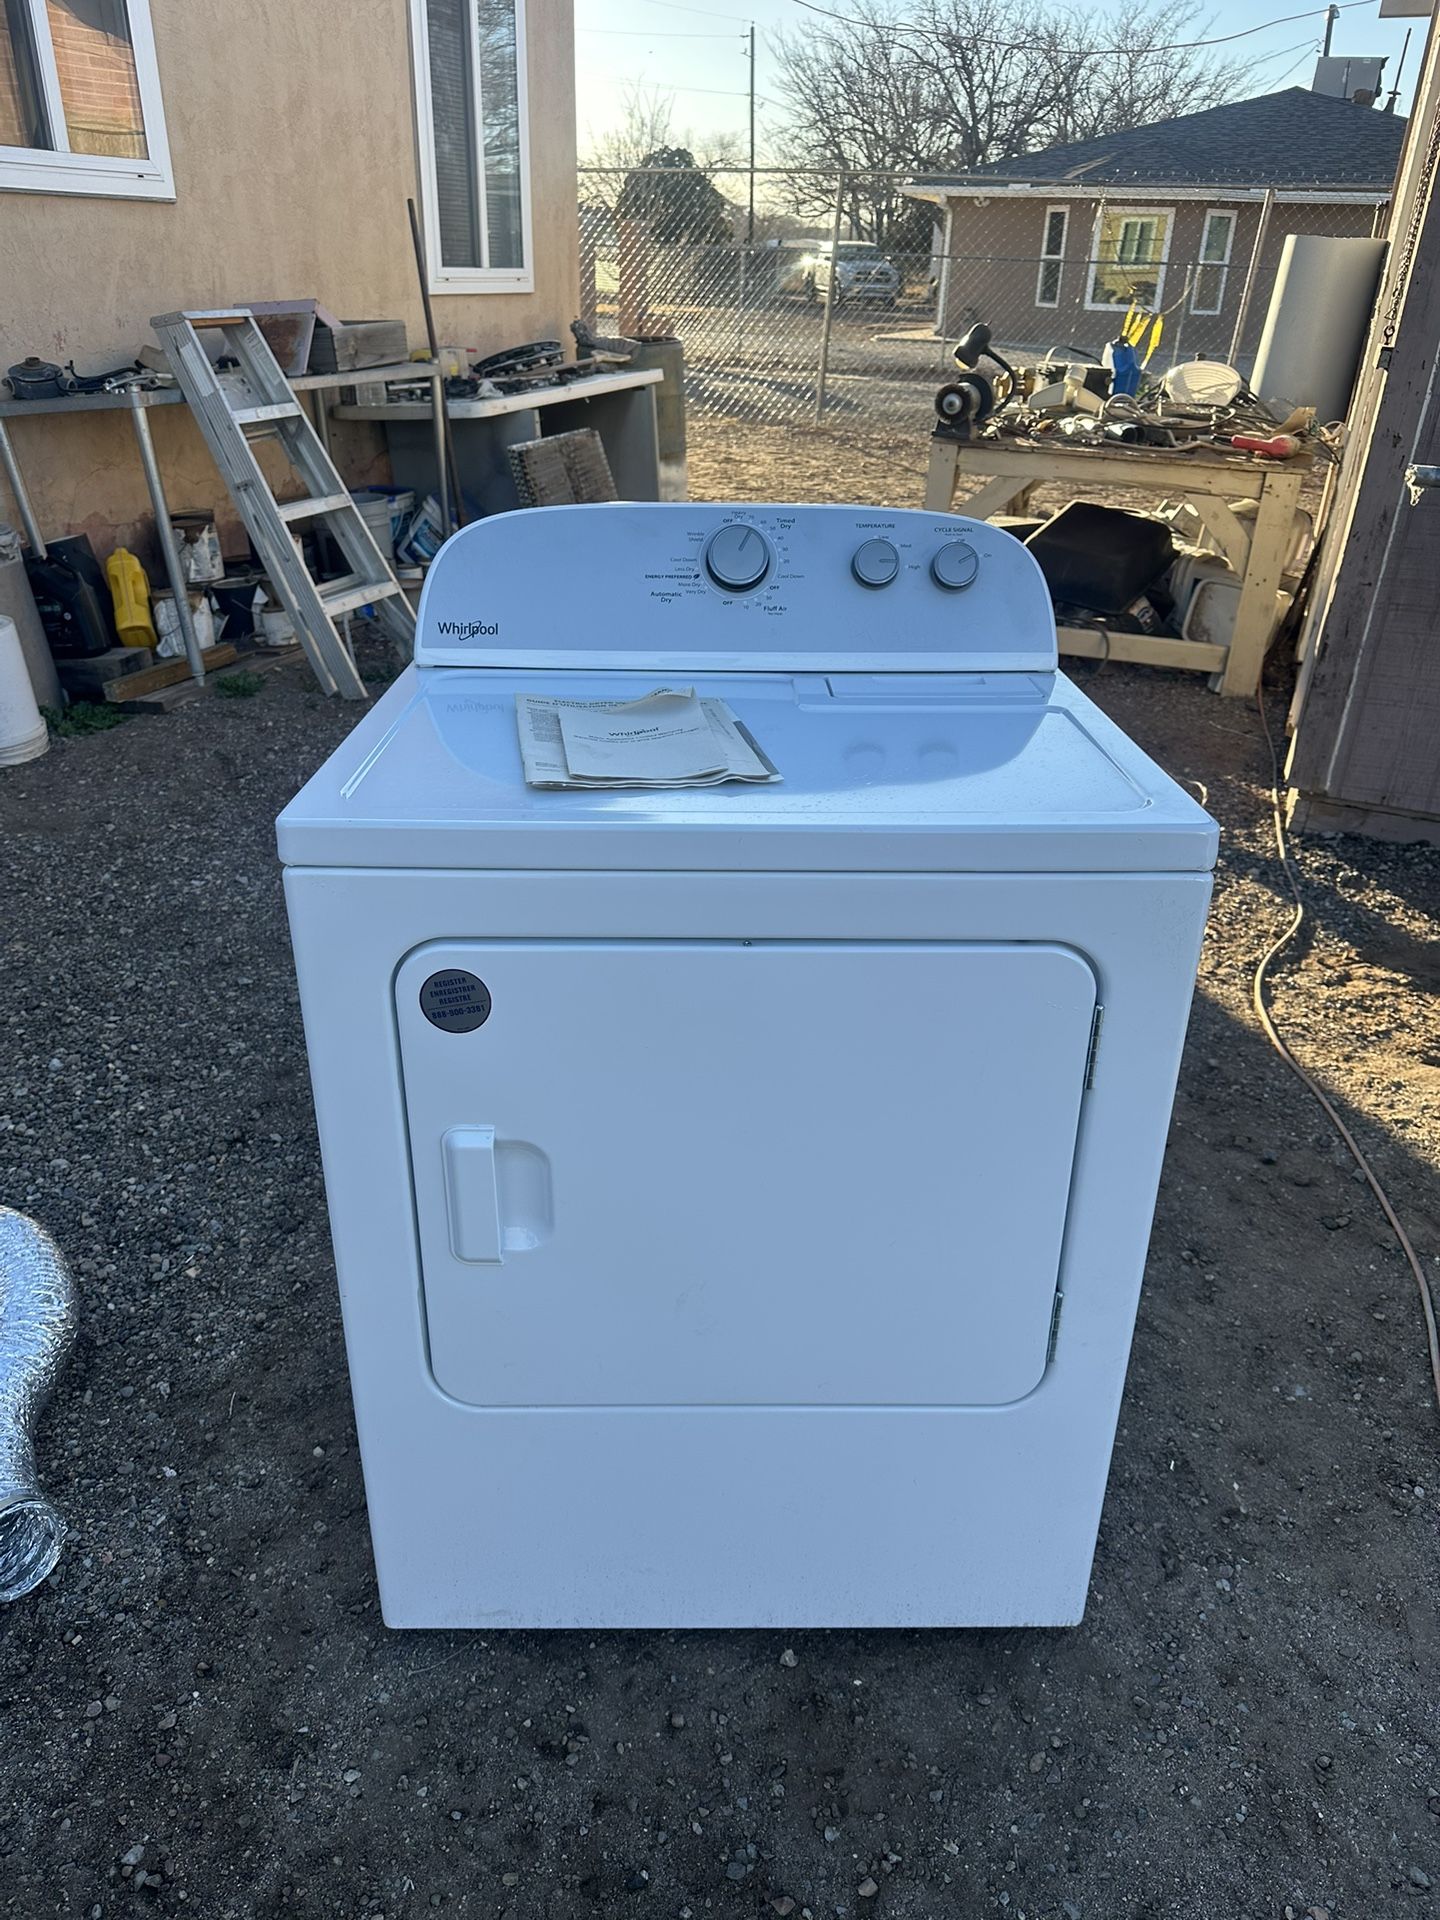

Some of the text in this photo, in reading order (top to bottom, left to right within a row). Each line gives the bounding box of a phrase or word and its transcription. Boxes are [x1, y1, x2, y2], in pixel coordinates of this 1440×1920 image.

[660, 596, 672, 604] Dry
[437, 620, 499, 641] Whirlpool
[433, 977, 467, 988] REGISTER
[430, 984, 477, 998] ENREGISTRER
[431, 1004, 486, 1019] 888-900-3381
